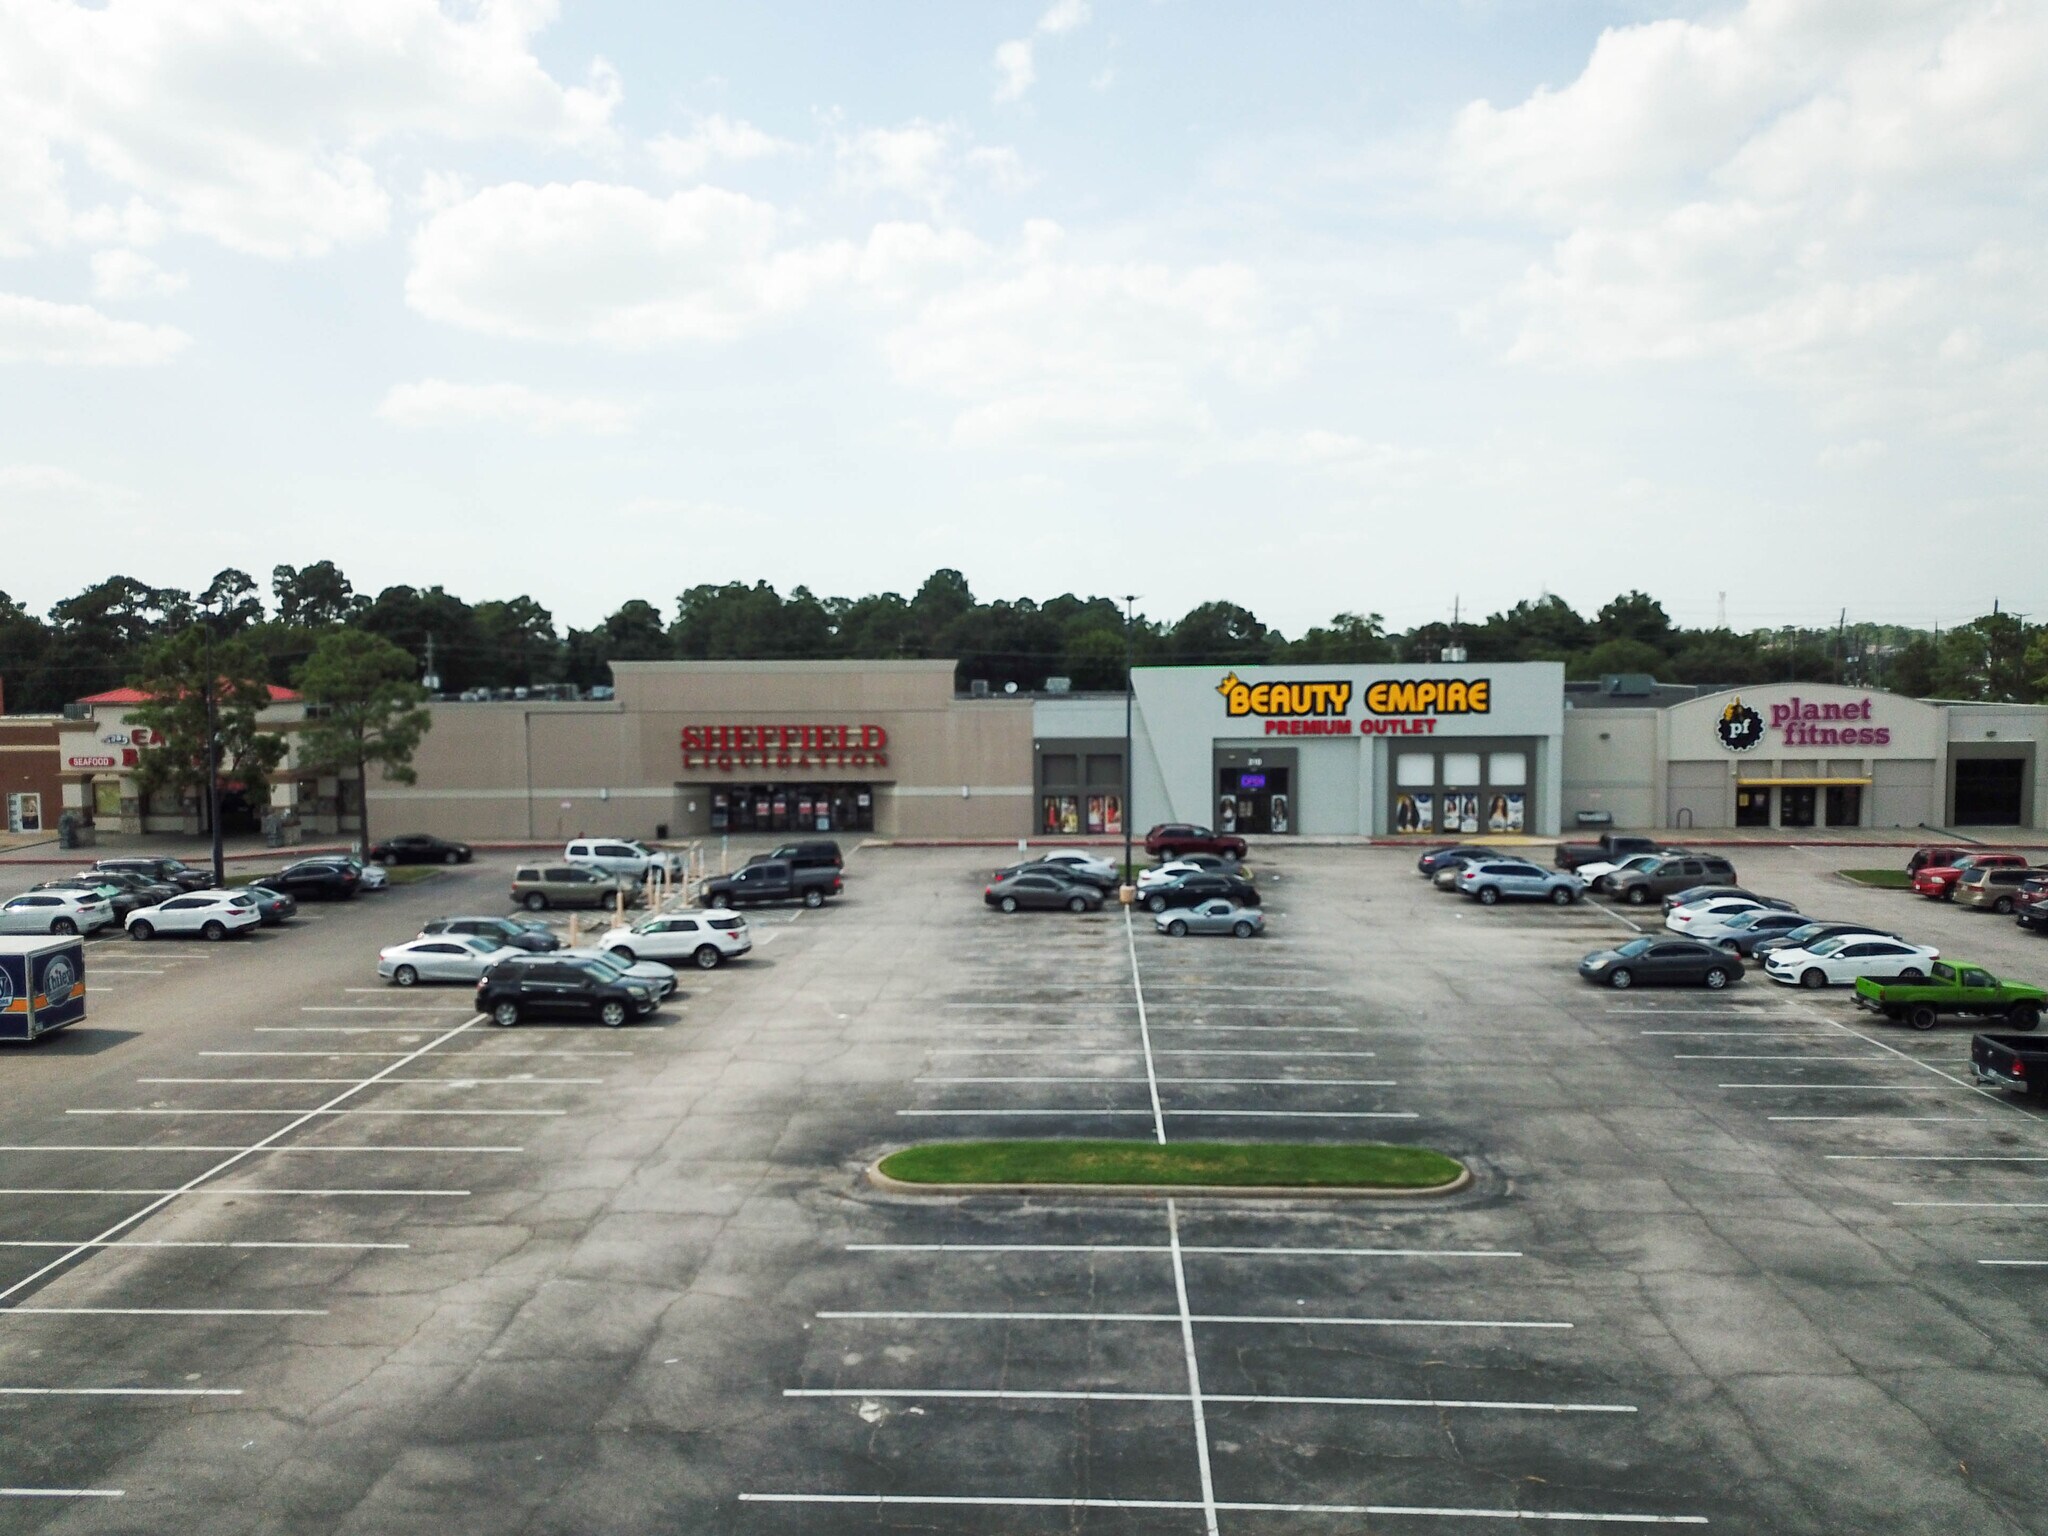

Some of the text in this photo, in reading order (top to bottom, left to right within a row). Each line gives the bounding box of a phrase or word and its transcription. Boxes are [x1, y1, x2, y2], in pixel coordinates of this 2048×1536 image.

[1227, 679, 1490, 716] BEAUTY EMPIRE
[1771, 697, 1872, 727] planet
[681, 724, 888, 751] SHEFFIELD
[1265, 719, 1437, 735] PREMIUM OUTLET
[1729, 718, 1751, 739] pf
[1783, 722, 1891, 746] fitness
[73, 757, 109, 767] SEAFOOD
[684, 753, 888, 771] LIQUIDATION
